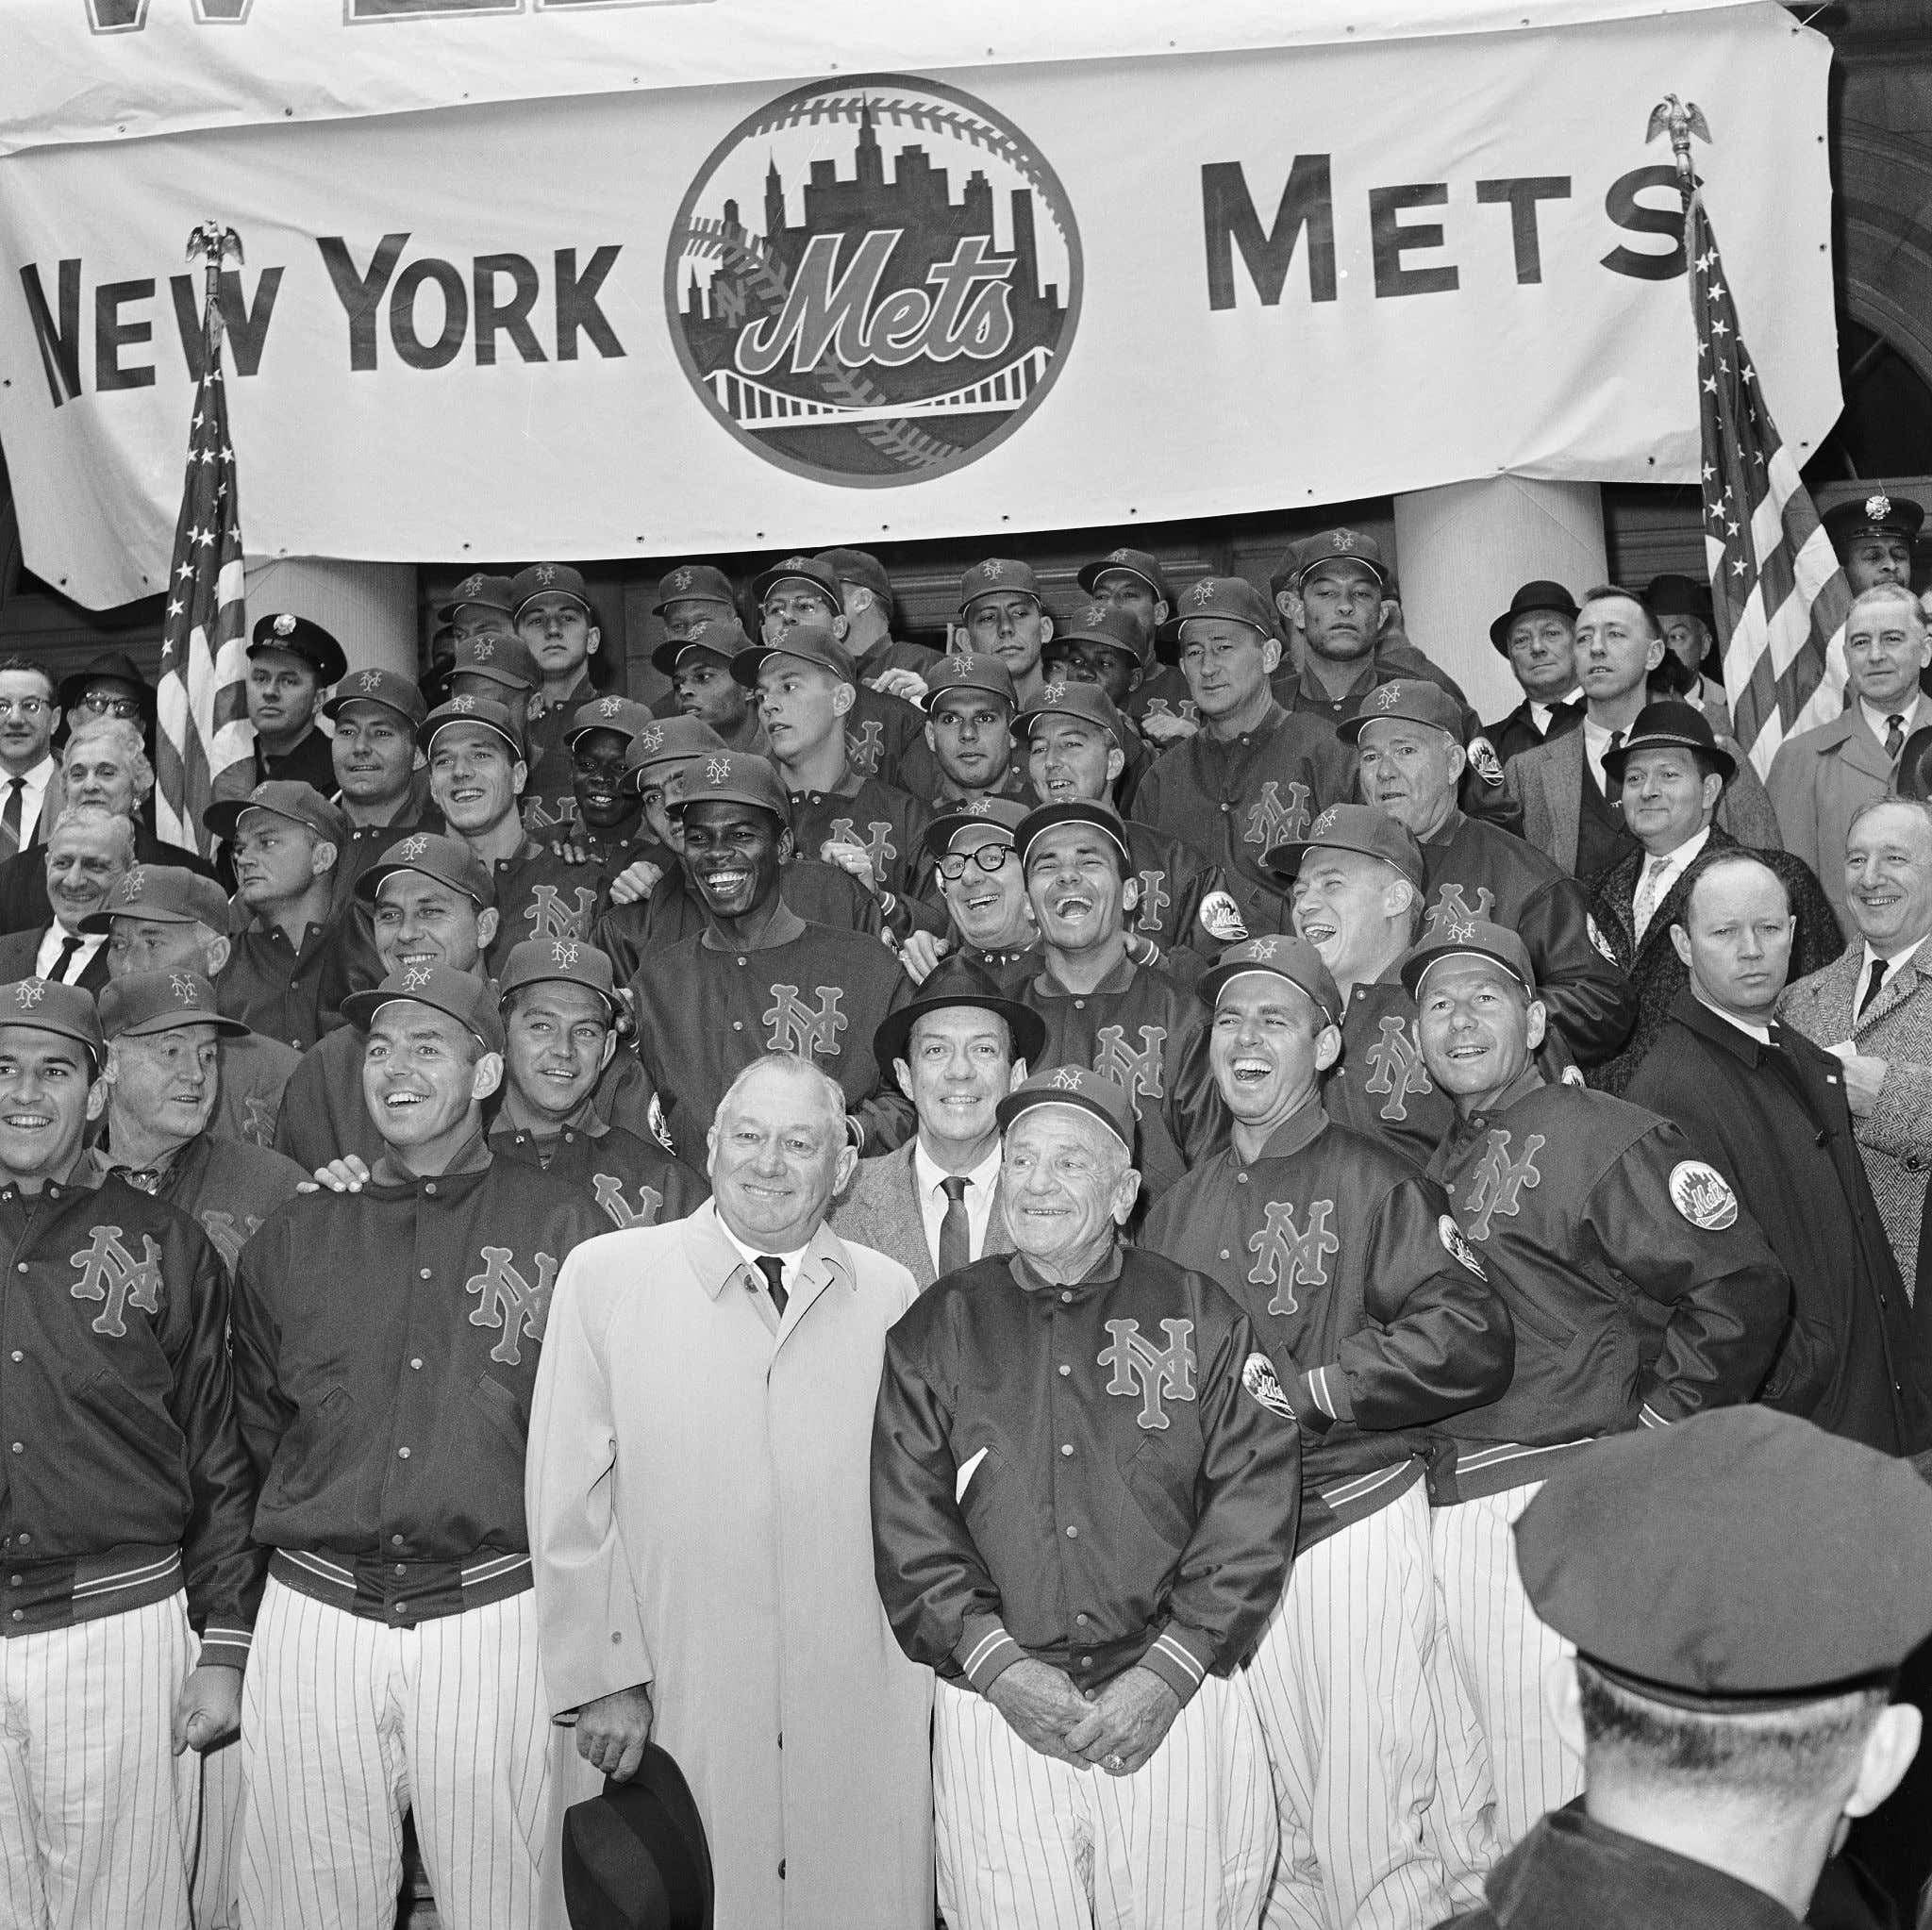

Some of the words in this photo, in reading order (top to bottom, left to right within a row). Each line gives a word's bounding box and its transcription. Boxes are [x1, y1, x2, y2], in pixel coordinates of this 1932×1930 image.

[20, 256, 286, 408] NEW
[316, 232, 627, 372] YORK
[1201, 153, 1705, 311] METS
[734, 227, 1018, 375] Mets
[706, 757, 732, 785] NY
[16, 978, 46, 1008] NY
[552, 941, 579, 969] NY
[71, 1225, 163, 1338] NY
[466, 1246, 558, 1365] NY
[1248, 1199, 1339, 1315] NY
[1097, 1318, 1196, 1430] NY
